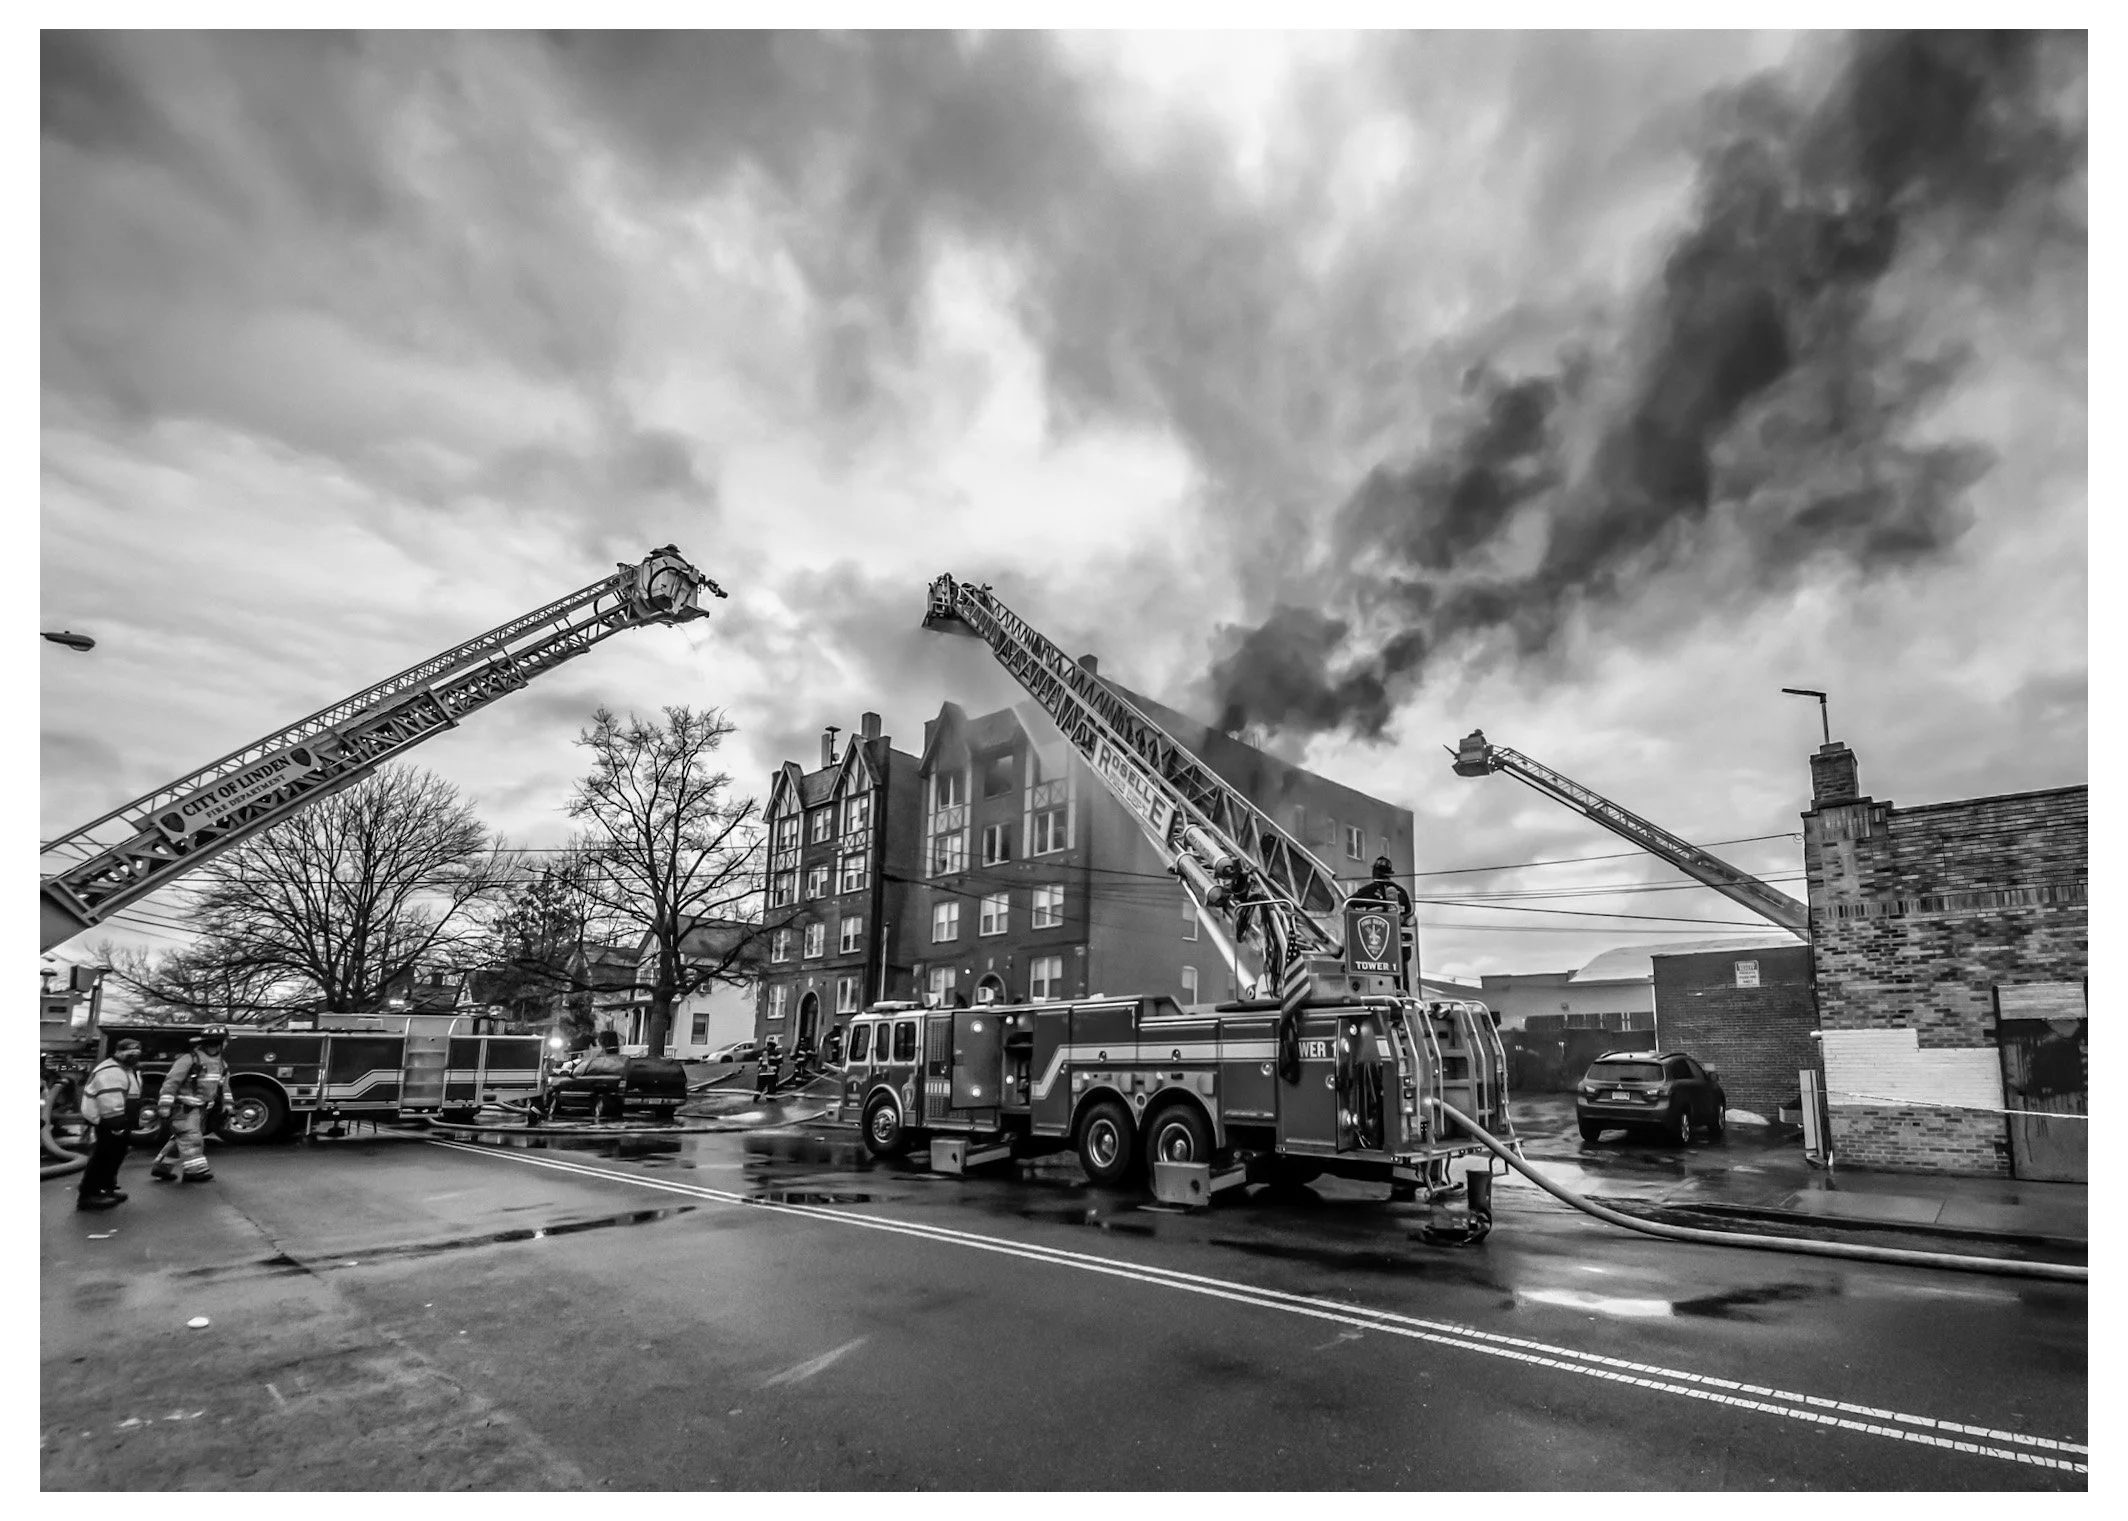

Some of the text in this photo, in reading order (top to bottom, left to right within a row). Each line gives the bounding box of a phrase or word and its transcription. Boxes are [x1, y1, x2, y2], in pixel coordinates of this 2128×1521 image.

[182, 756, 291, 817] CITY OF LINDEN
[205, 773, 286, 819] FIRE DEPARTMENT
[1099, 743, 1166, 831] ROSELLE
[1355, 961, 1397, 971] TOWER 1
[1298, 1041, 1337, 1058] WER 1
